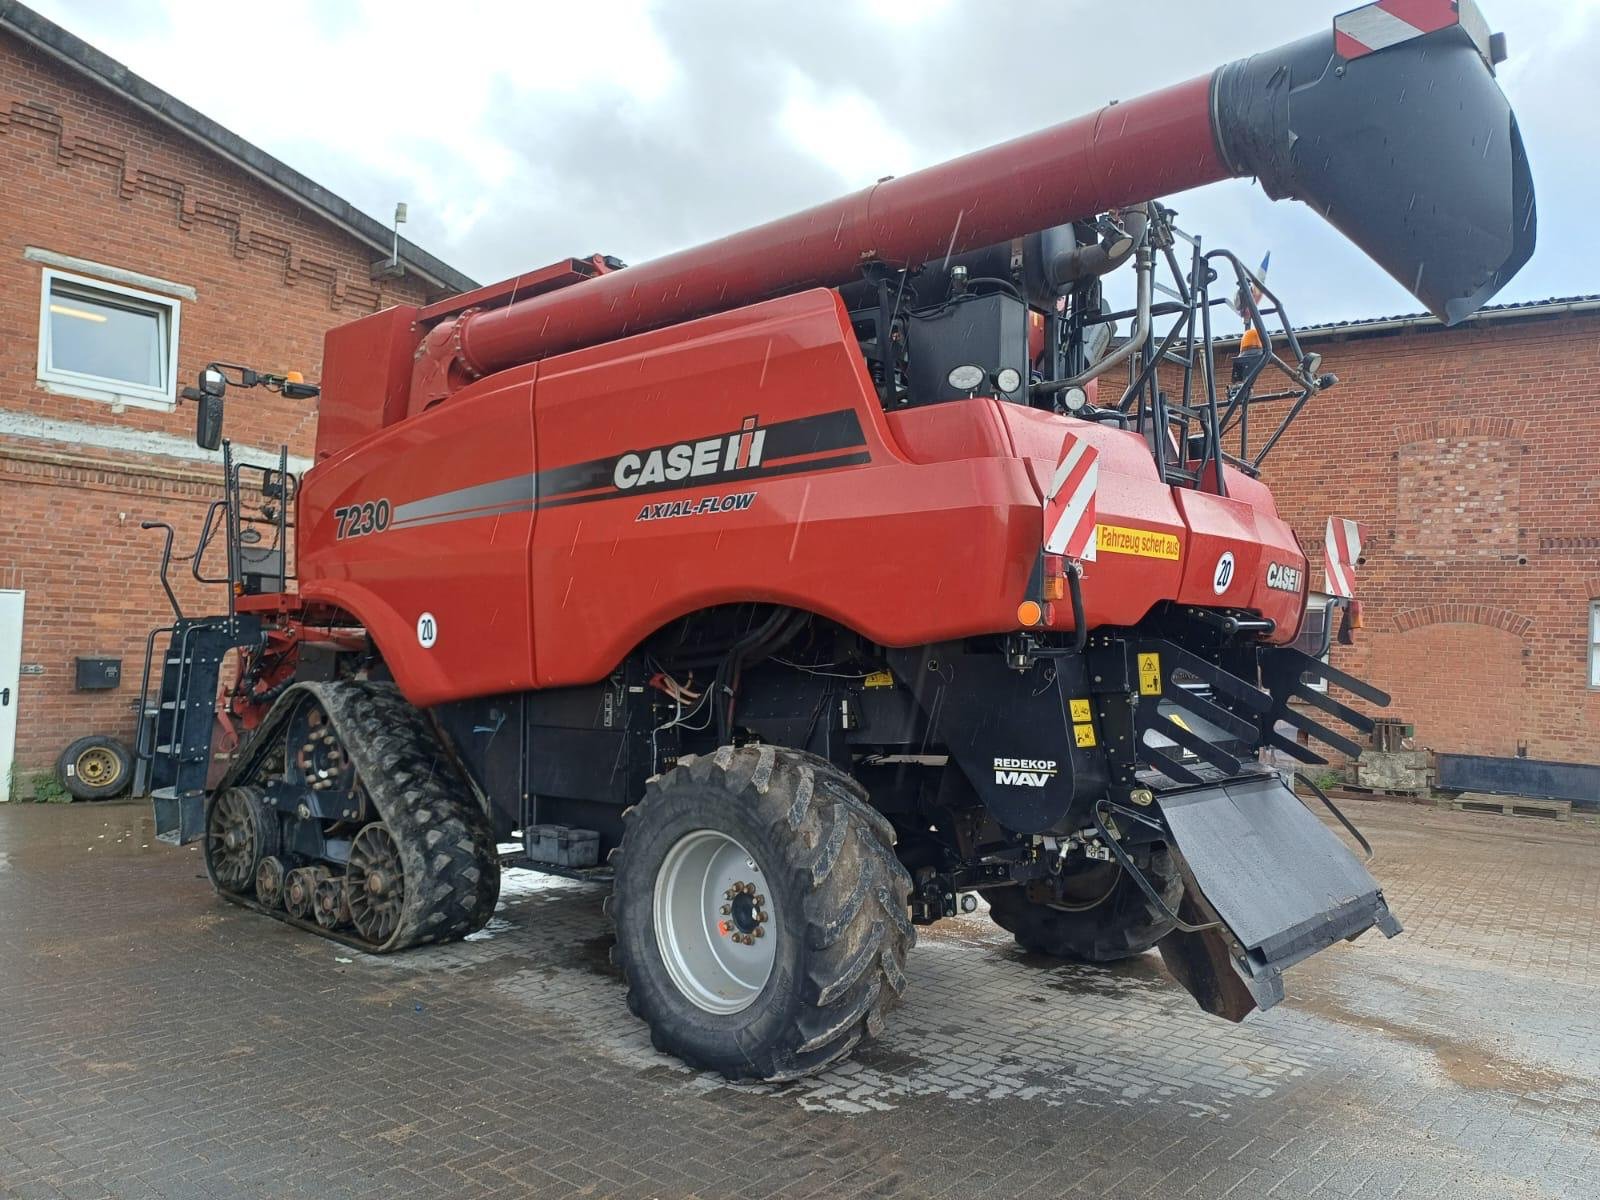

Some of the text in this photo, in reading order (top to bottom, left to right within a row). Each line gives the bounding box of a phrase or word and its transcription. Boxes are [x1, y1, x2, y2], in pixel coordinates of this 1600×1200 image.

[334, 498, 390, 541] 7230
[635, 492, 758, 522] AXIAL-FLOW
[1101, 525, 1140, 553] Fahrzeug
[1141, 534, 1165, 553] schert
[1166, 540, 1178, 556] aus
[1216, 559, 1232, 587] 20
[421, 619, 433, 641] 20
[993, 757, 1057, 770] REDEKOP
